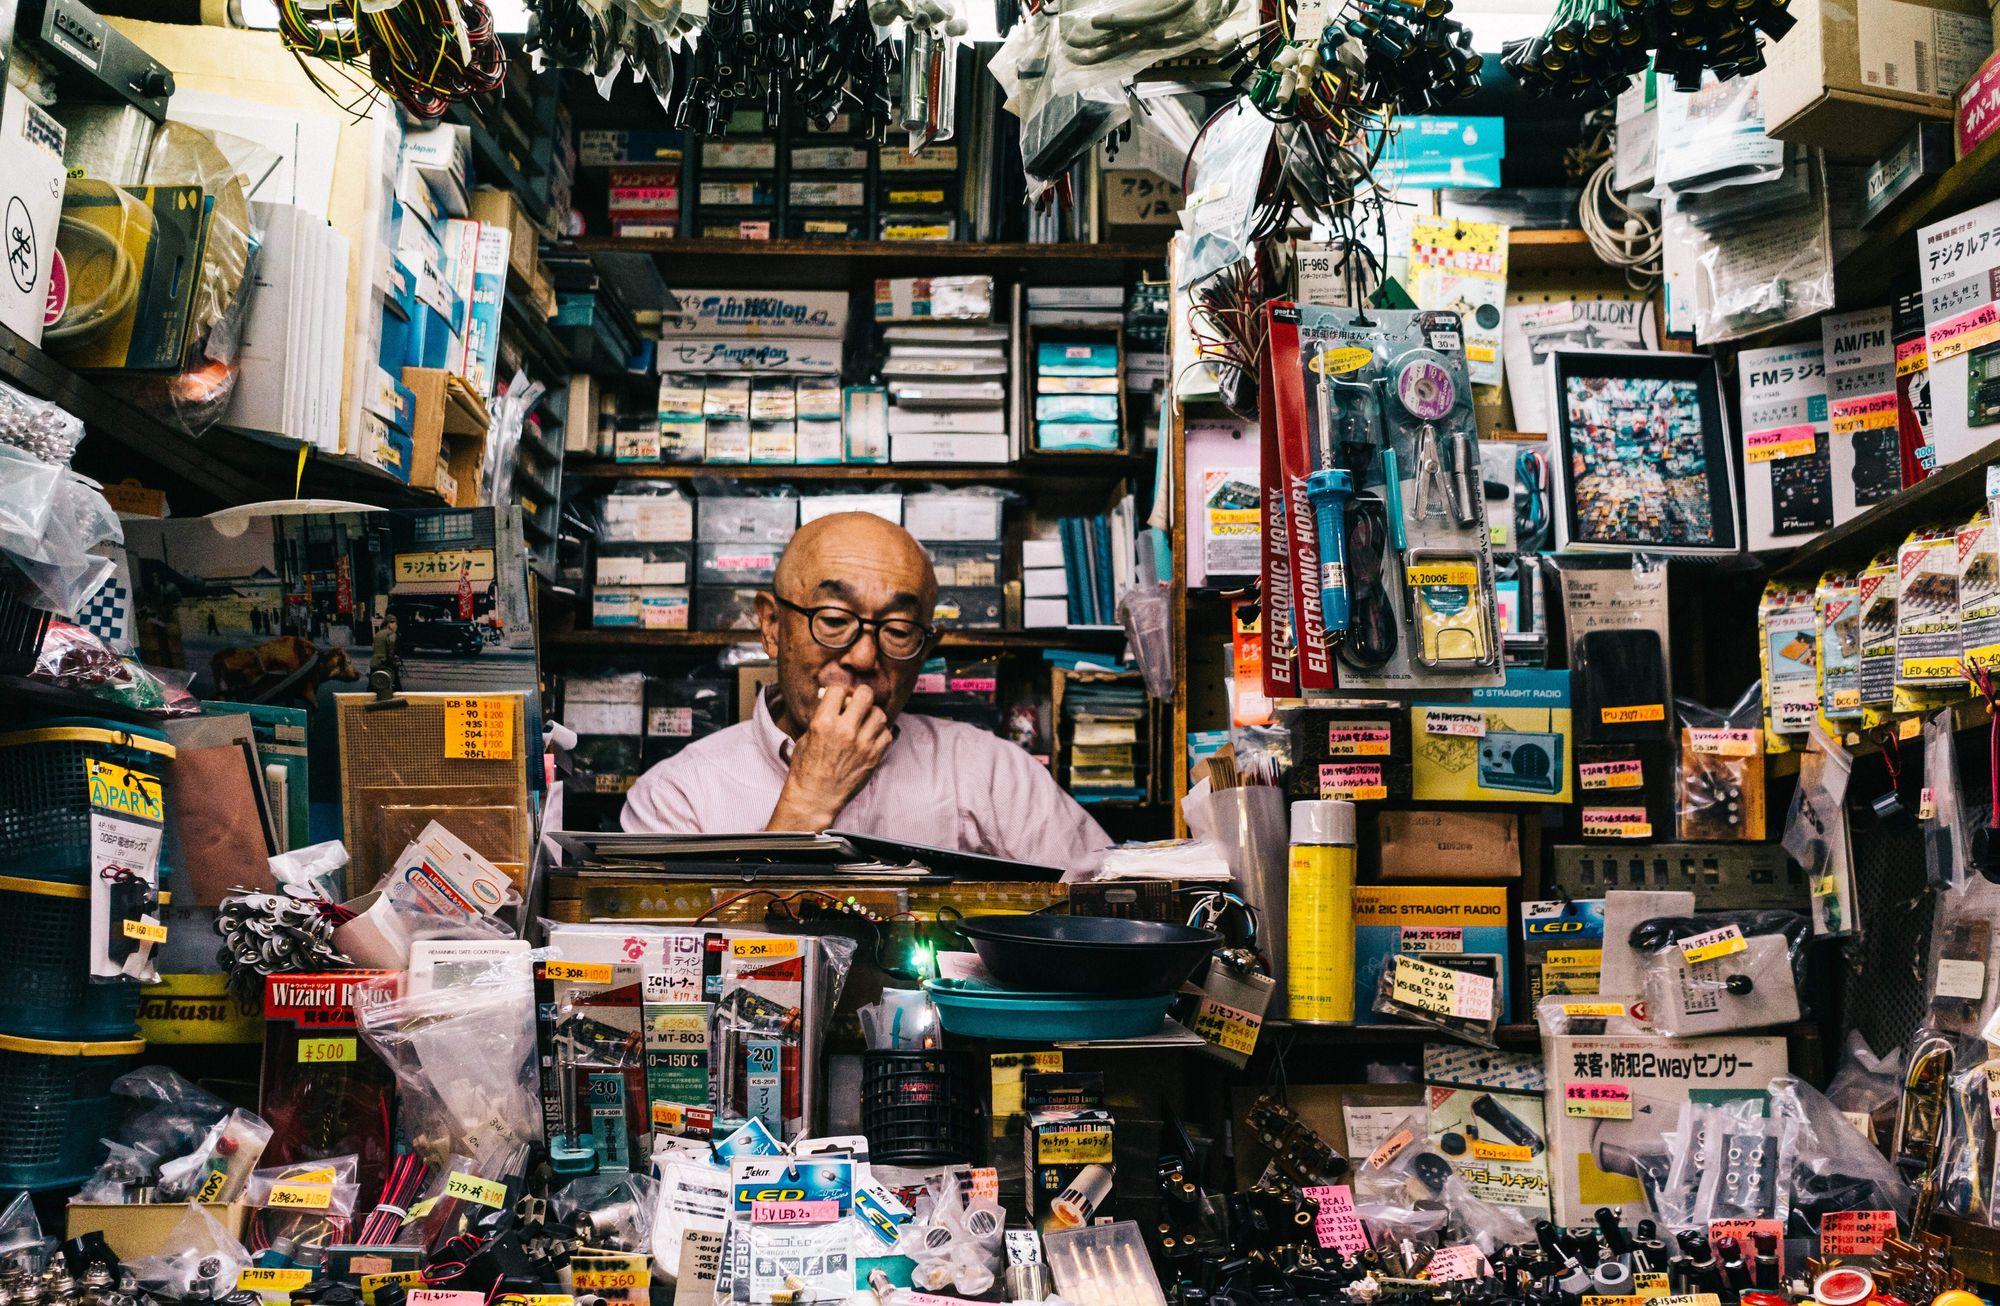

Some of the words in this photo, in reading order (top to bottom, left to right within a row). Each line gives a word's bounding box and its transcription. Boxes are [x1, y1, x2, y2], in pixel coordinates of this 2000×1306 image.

[1932, 283, 1979, 305] はんだ付け
[1834, 330, 1885, 355] AM/FM
[1291, 474, 1315, 544] HOBBY
[1269, 486, 1288, 552] HOBBY
[403, 560, 486, 573] ラジオセンター
[1410, 574, 1448, 584] X-2000E
[1298, 548, 1328, 673] ELECTRONIC
[1270, 557, 1291, 684] ELECTRONIC
[1486, 689, 1531, 698] STRAIGHT
[1533, 689, 1562, 698] RADIO
[1357, 905, 1375, 915] AM
[1401, 904, 1461, 915] STRAIGHT
[1464, 905, 1502, 915] RADIO
[1529, 922, 1583, 934] LED
[734, 945, 768, 955] KS-20R
[547, 966, 584, 978] KS-30R
[1442, 971, 1452, 979] 2A
[648, 975, 695, 987] ICトレーナー
[271, 982, 336, 1006] Wizard
[1437, 992, 1448, 1002] 3A
[1209, 1003, 1245, 1021] リモコン
[662, 1018, 699, 1028] ¥2800
[658, 1034, 705, 1043] MT-803
[1222, 1035, 1252, 1052] ¥3980
[304, 1042, 345, 1060] ¥500
[753, 1048, 774, 1062] 20
[1574, 1051, 1753, 1079] 来客・防犯2wayセンサー
[594, 1081, 618, 1095] 30
[1068, 1096, 1080, 1104] LED
[654, 1110, 677, 1122] ¥300
[1059, 1124, 1078, 1133] Color
[1080, 1124, 1092, 1133] LED
[738, 1189, 805, 1203] LED
[754, 1207, 776, 1221] 1.5V
[779, 1208, 796, 1220] LED
[1857, 1212, 1871, 1221] 8P
[1824, 1223, 1838, 1232] 4P
[1856, 1223, 1872, 1232] 10P
[1823, 1236, 1838, 1244] 5P
[1855, 1236, 1872, 1244] 12P
[1823, 1245, 1838, 1254] 6P
[736, 1242, 749, 1279] RED
[243, 1269, 275, 1280] F-7159
[599, 1275, 636, 1287] ¥360
